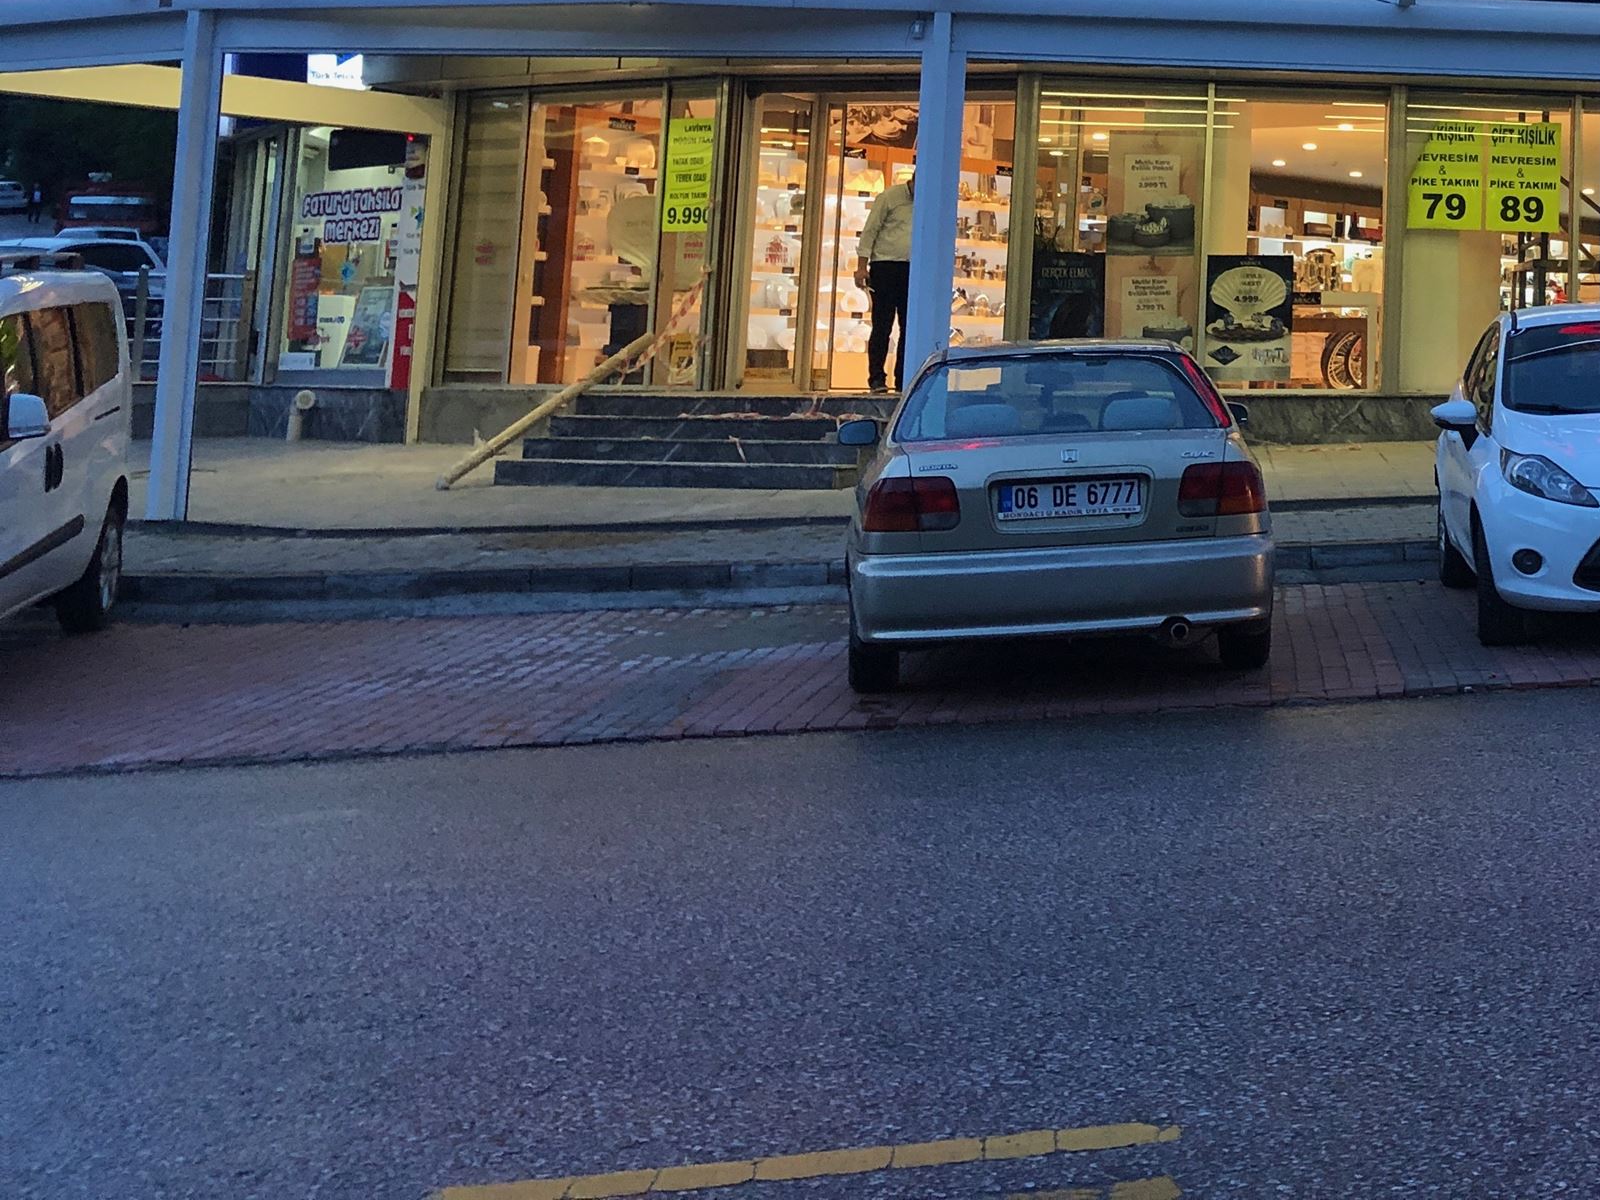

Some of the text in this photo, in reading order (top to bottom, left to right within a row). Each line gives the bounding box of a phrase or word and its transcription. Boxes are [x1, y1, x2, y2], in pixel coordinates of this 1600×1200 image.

[1491, 155, 1557, 166] NEVRESİM
[1411, 176, 1479, 187] PİKE TAKIMI
[1489, 178, 1557, 190] PİKE TAKIMI
[1422, 193, 1467, 221] 79
[1499, 195, 1545, 223] 89
[1014, 481, 1136, 510] 06 DE 6777
